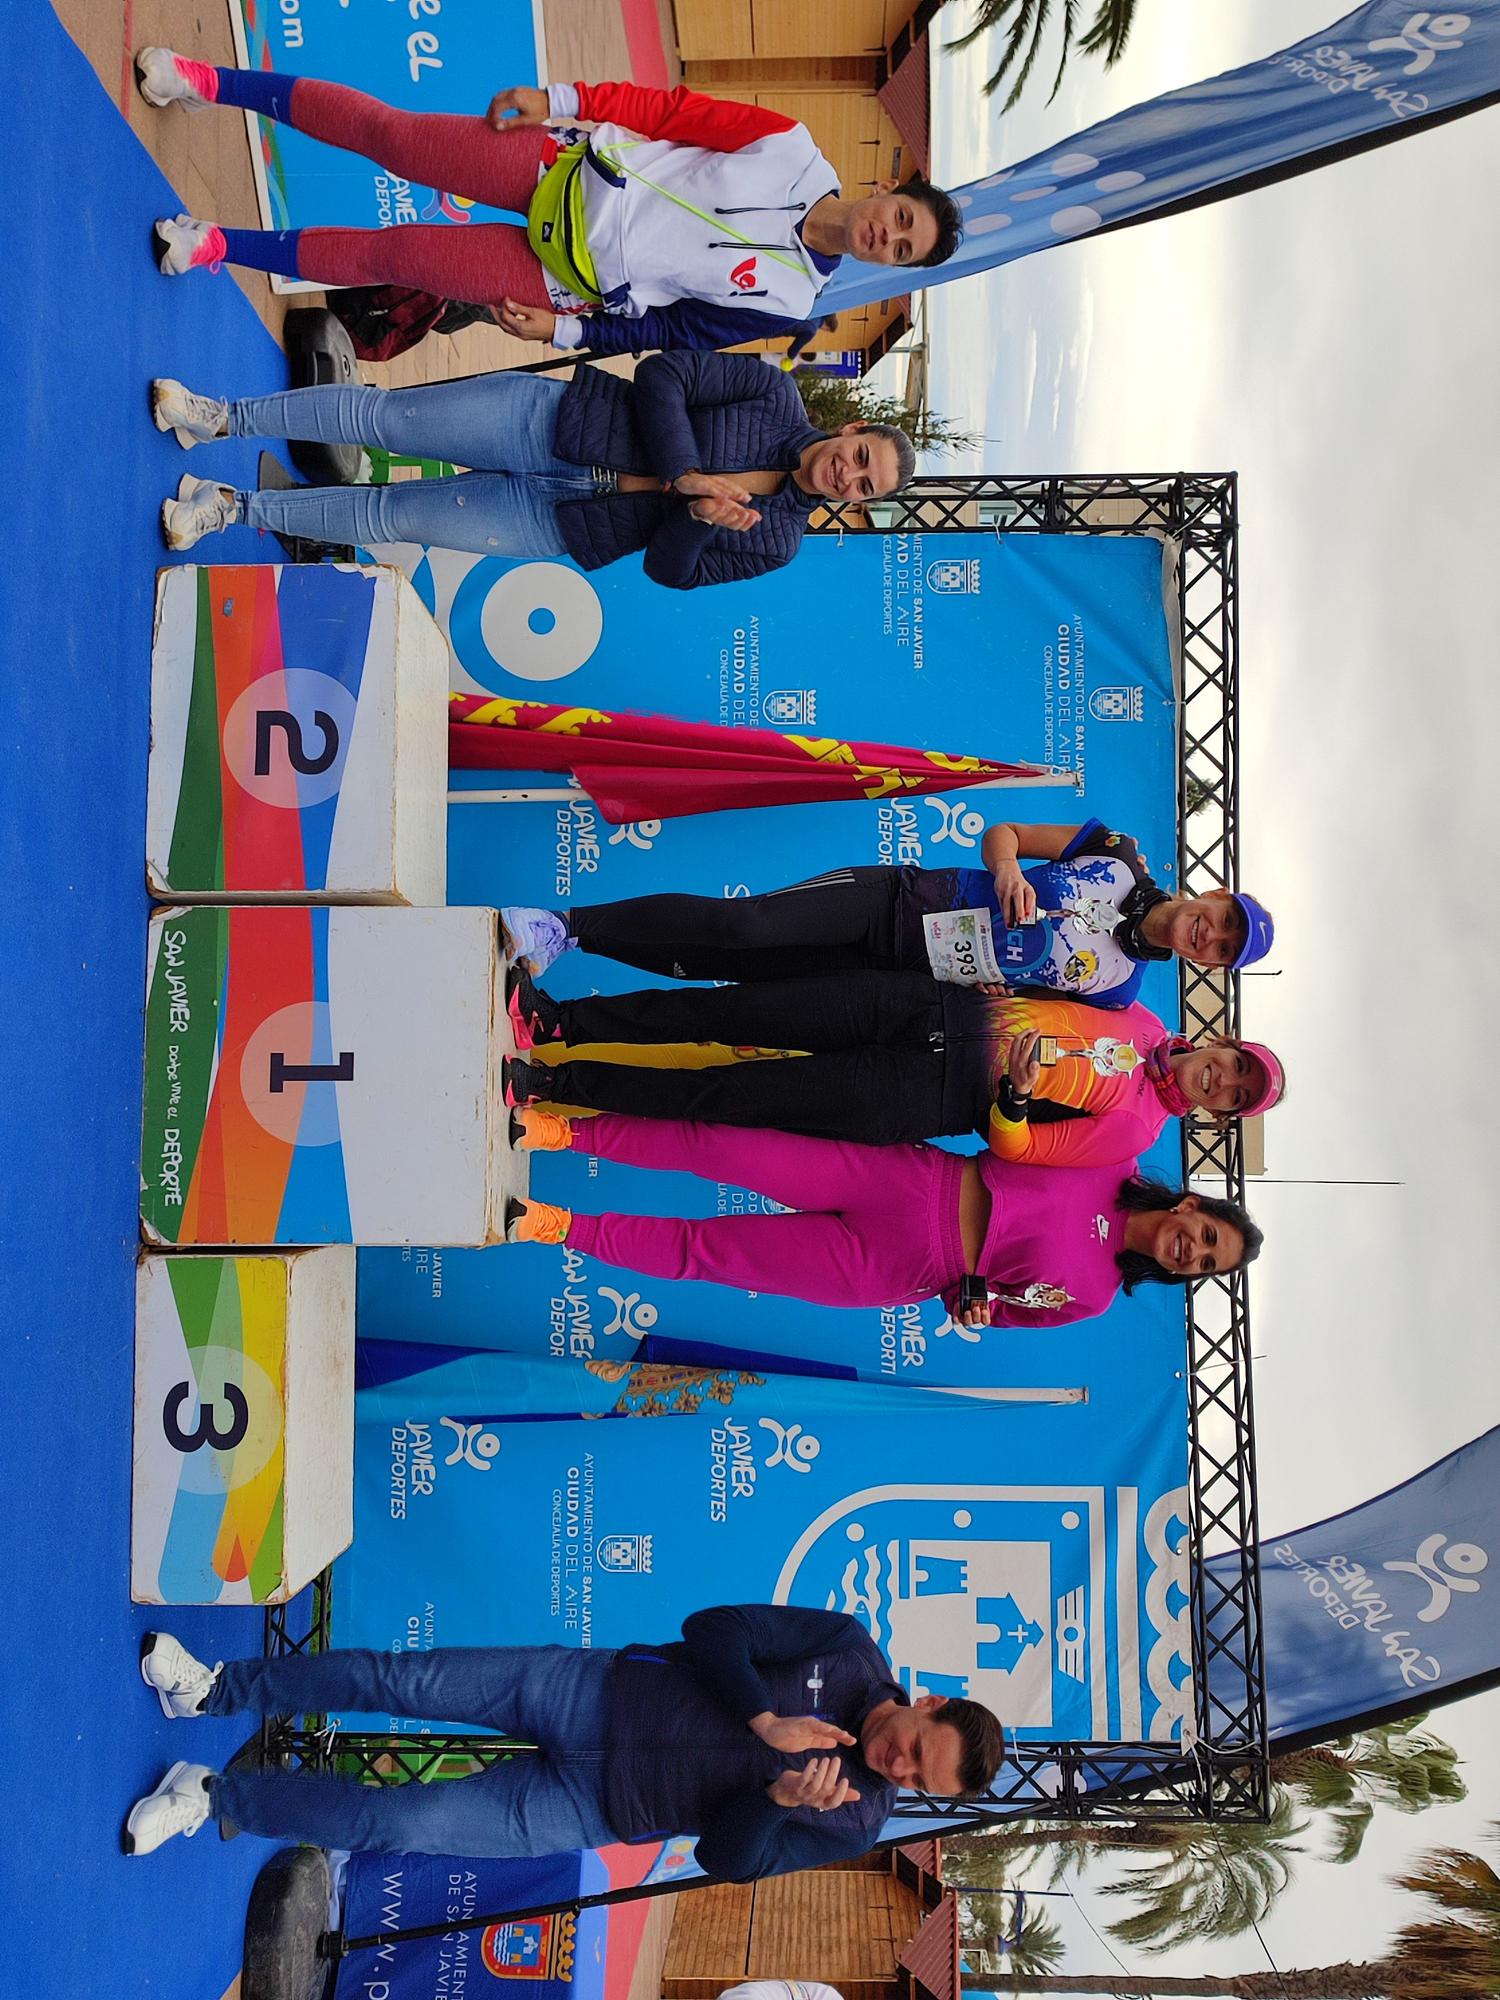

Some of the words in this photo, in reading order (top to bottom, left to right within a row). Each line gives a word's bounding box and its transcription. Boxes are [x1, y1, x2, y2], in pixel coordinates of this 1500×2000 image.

[883, 576, 892, 587] DE
[897, 570, 908, 599] DEL
[913, 580, 922, 594] DE
[883, 589, 892, 634] DEPORTES
[897, 606, 909, 646] AIRE
[913, 598, 922, 622] SAN
[734, 629, 745, 693] CIUDAD
[750, 616, 759, 706] AYUNTAMIENTO
[913, 626, 922, 669] JAVIER
[1058, 624, 1070, 690] CIUDAD
[1073, 614, 1084, 704] AYUNTAMIENTO
[720, 649, 730, 703] CONCEJALÍA
[1043, 645, 1054, 700] CONCEJALÍA
[720, 706, 728, 718] DE
[734, 700, 745, 728] DEL
[750, 710, 758, 726] DE
[1044, 702, 1053, 715] DE
[1058, 696, 1070, 727] DEL
[1076, 706, 1084, 722] DE
[254, 710, 339, 776] 2
[1044, 717, 1053, 762] DEPORTES
[1075, 725, 1084, 750] SAN
[556, 810, 571, 896] DEPORTES
[569, 800, 600, 873] JAVIER
[164, 930, 187, 966] SAN
[954, 941, 977, 976] 393
[1007, 930, 1023, 961] GH
[165, 968, 190, 1032] JAVIER
[270, 1052, 355, 1093] 1
[159, 1128, 183, 1206] DEPORTE
[732, 1193, 744, 1214] DE
[416, 1249, 428, 1274] IRE
[432, 1252, 442, 1298] JAVIER
[163, 1381, 249, 1453] 3
[390, 1427, 407, 1520] DEPORTES
[405, 1416, 436, 1496] JAVIER
[711, 1428, 726, 1522] DEPORTES
[724, 1417, 756, 1498] JAVIER
[552, 1489, 562, 1548] CONCEJALÍA
[567, 1467, 579, 1538] CIUDAD
[583, 1453, 594, 1552] AYUNTAMIENTO
[552, 1551, 561, 1564] DE
[566, 1544, 578, 1577] DEL
[583, 1556, 592, 1572] DE
[551, 1566, 561, 1616] DEPORTES
[565, 1585, 578, 1629] AIRE
[582, 1576, 592, 1603] SAN
[448, 1874, 462, 1896] DE
[452, 1871, 477, 2000] AYUNAMIENT
